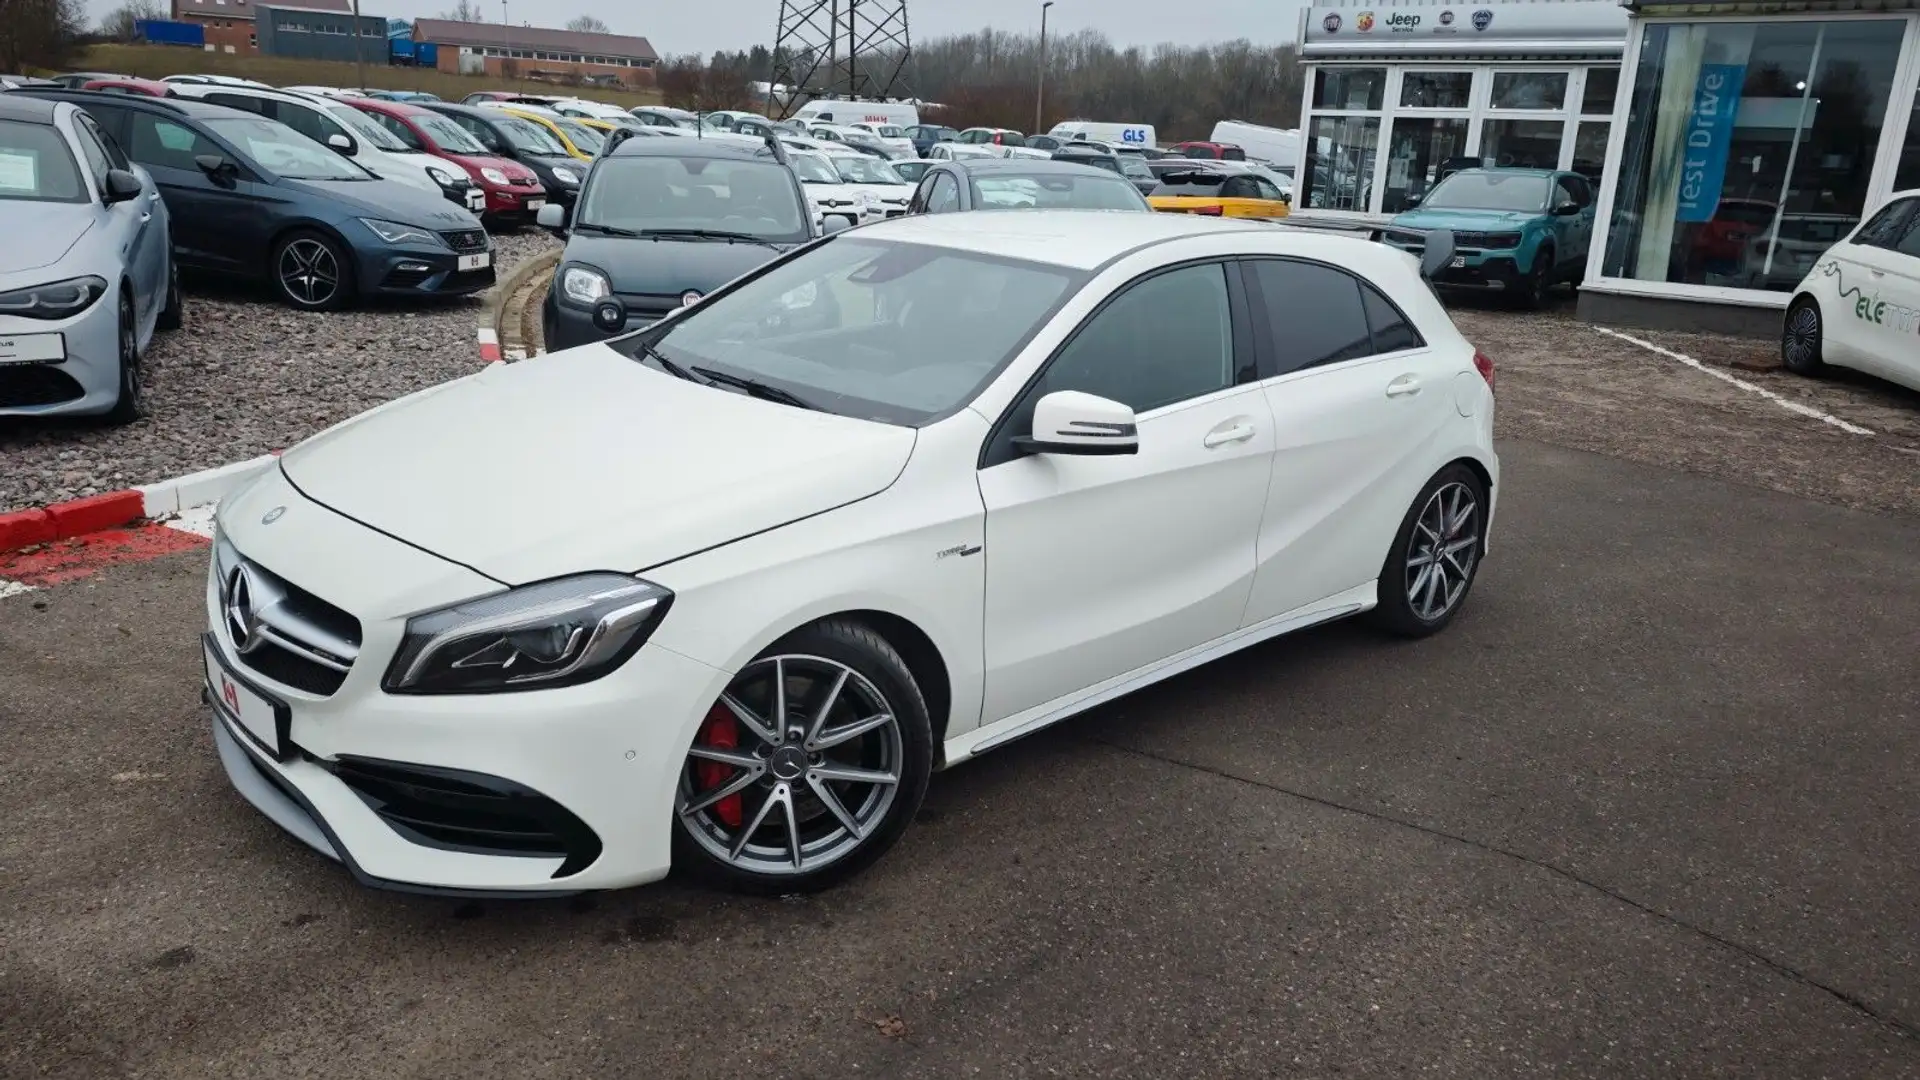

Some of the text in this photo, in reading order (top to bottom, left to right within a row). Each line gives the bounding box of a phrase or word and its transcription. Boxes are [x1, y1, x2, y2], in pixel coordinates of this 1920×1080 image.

[1385, 12, 1421, 27] Jeep
[1688, 73, 1724, 148] Drive
[1123, 129, 1145, 142] GLS
